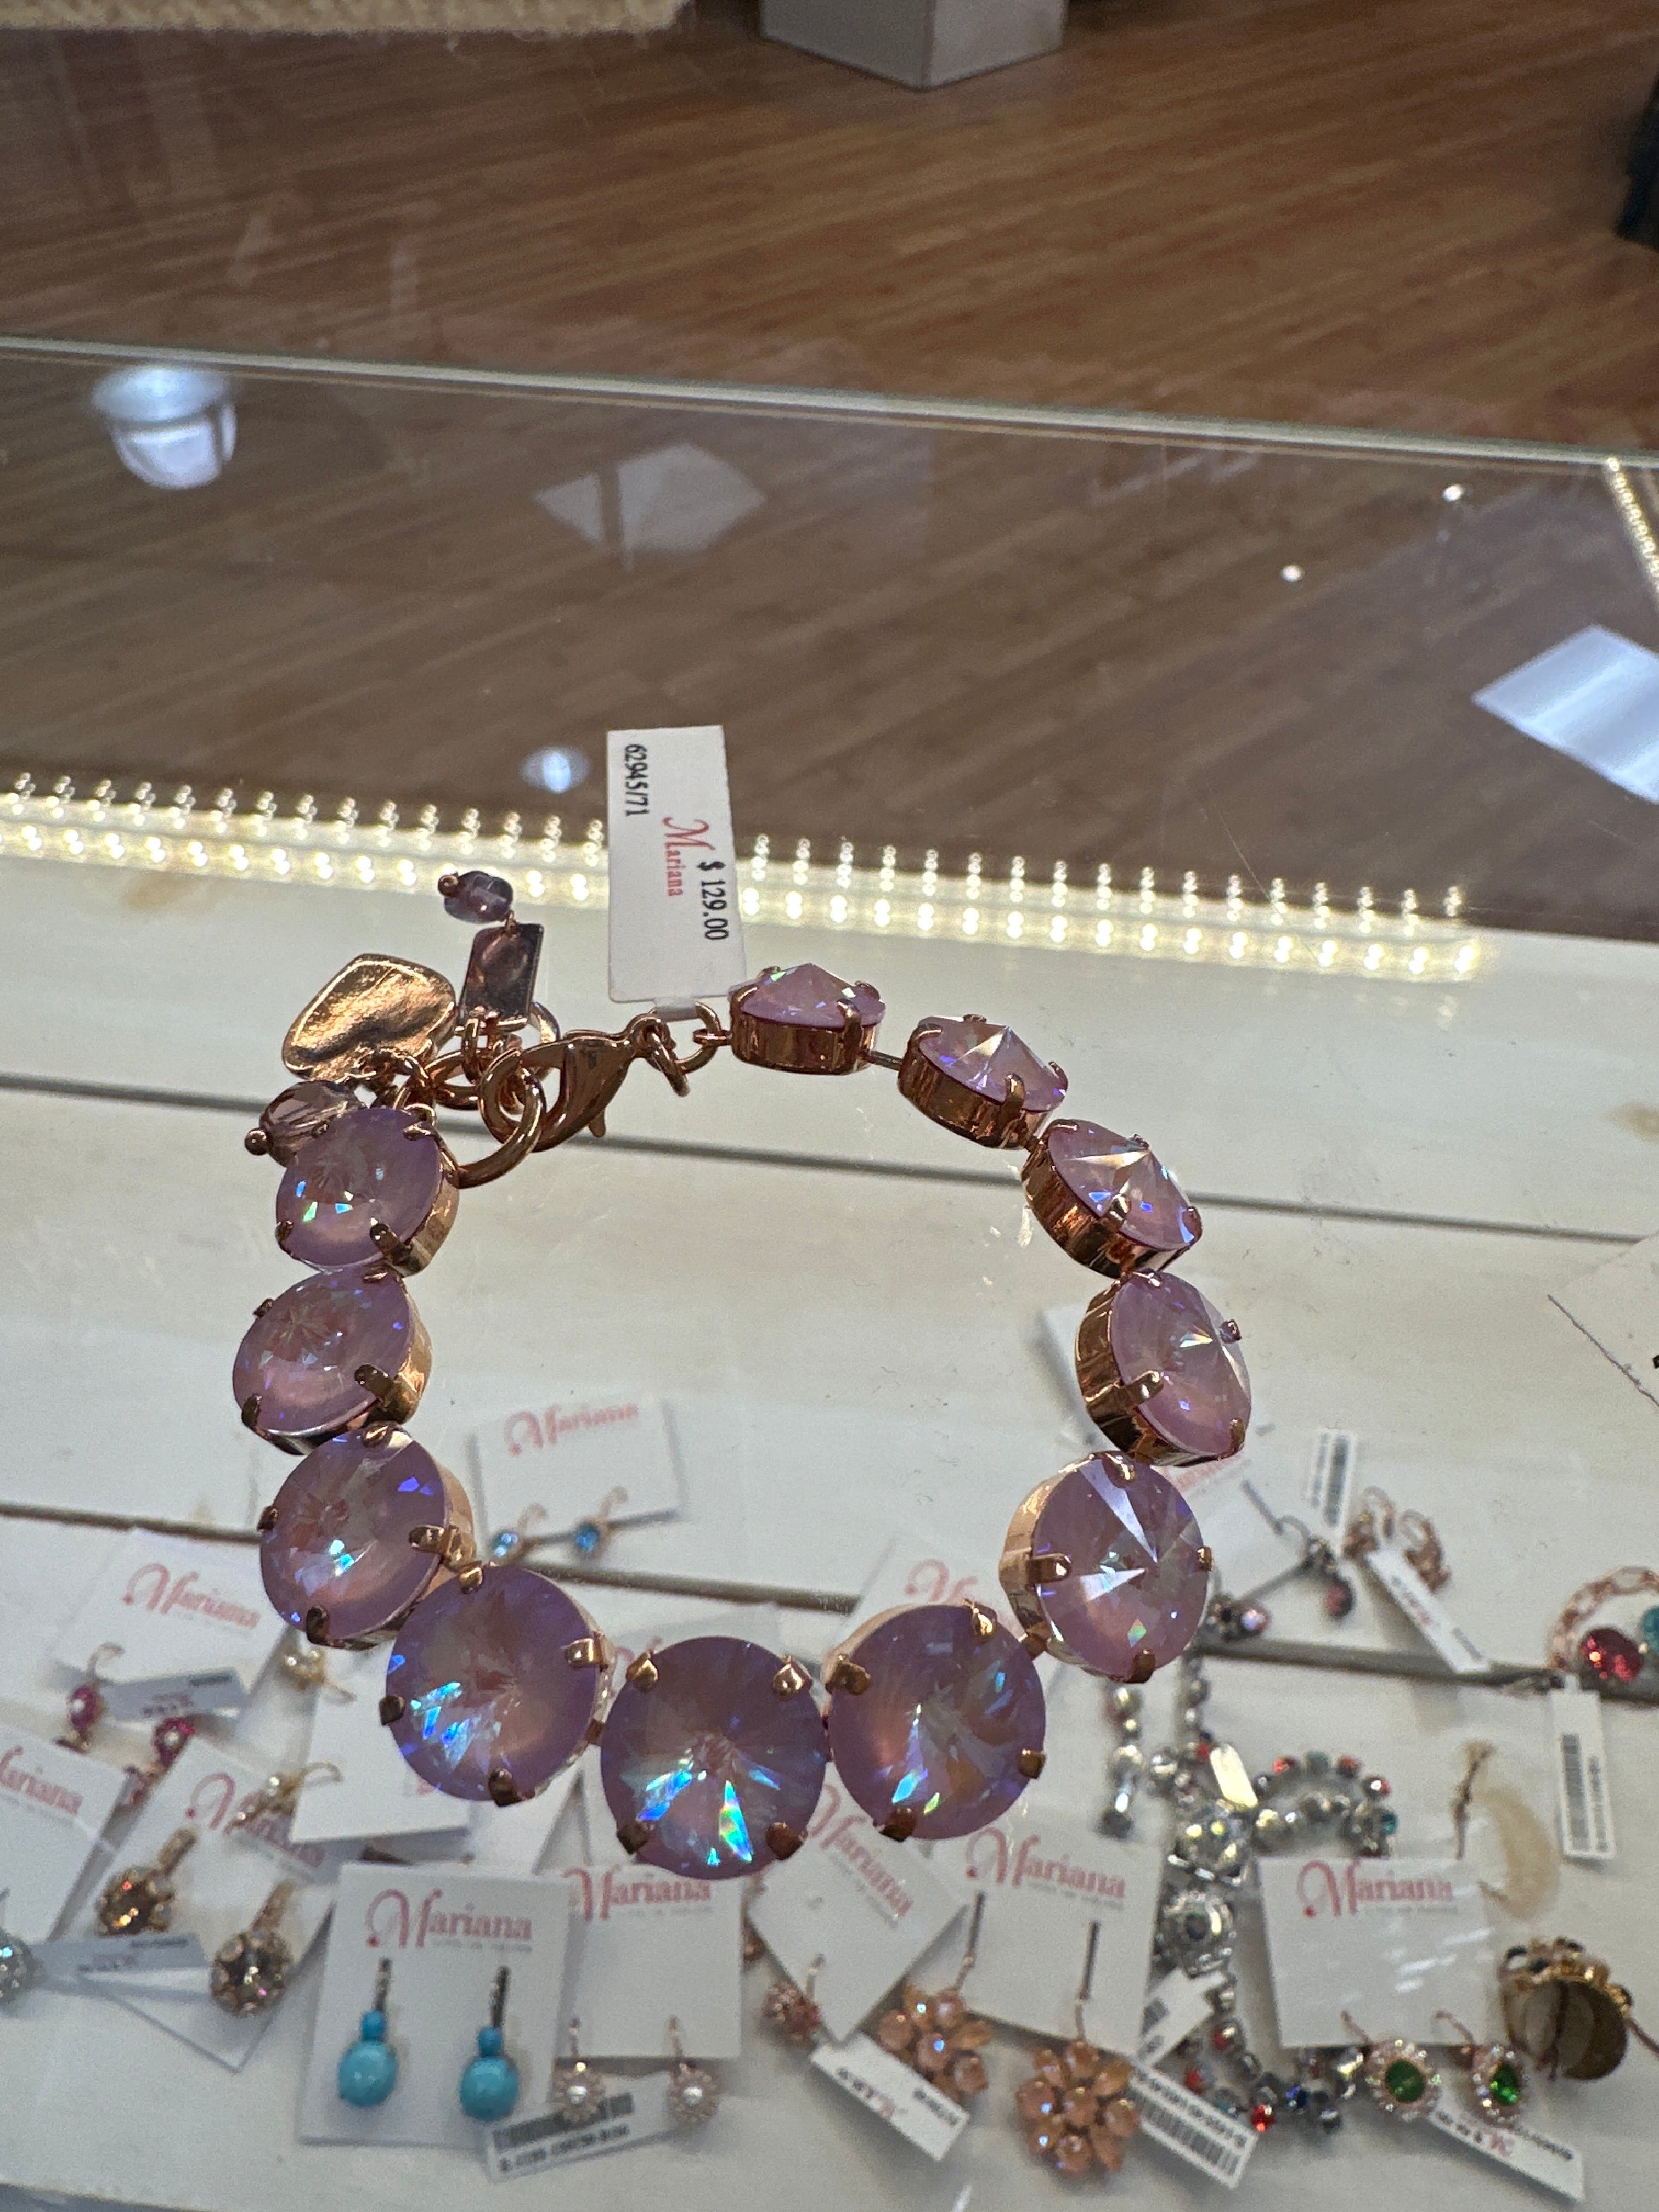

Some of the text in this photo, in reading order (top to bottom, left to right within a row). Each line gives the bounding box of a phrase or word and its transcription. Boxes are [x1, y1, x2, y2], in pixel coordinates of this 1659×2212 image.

[624, 743, 649, 816] 62945/71
[662, 816, 715, 897] Mariana
[697, 860, 730, 940] $ 129.00
[965, 1825, 1126, 1899] Mariana
[1296, 1857, 1454, 1918] Mariana
[365, 1888, 532, 1949] Mariana
